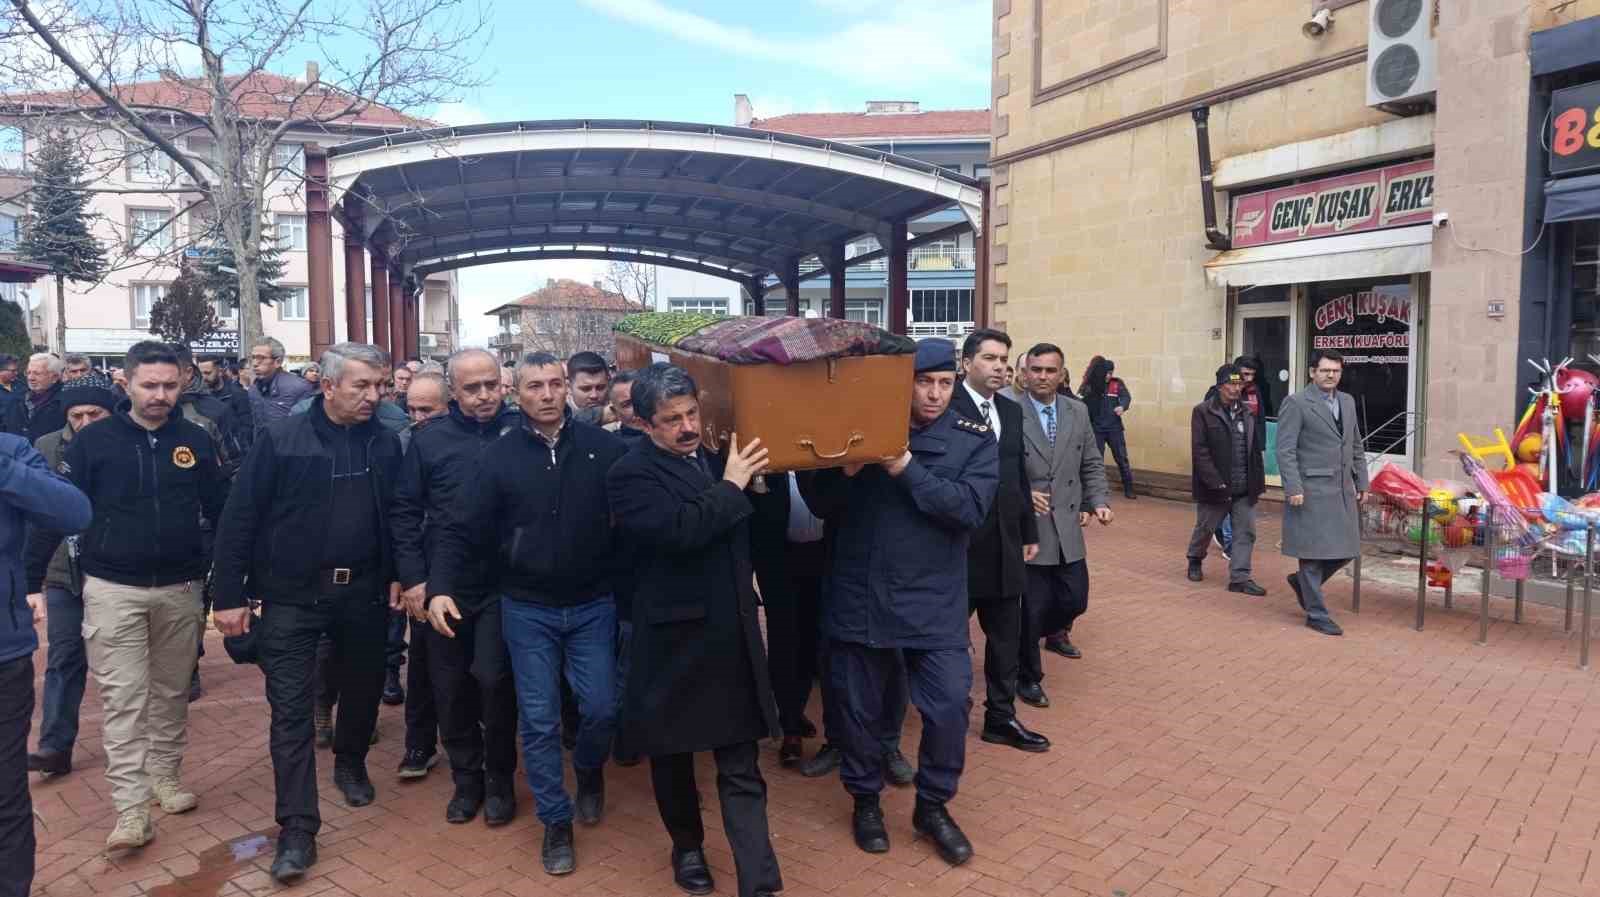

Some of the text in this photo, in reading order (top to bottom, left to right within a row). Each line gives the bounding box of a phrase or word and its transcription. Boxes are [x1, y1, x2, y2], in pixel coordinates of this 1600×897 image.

[1272, 185, 1376, 233] GENÇ KUŞAK
[1315, 291, 1410, 330] GENÇ KUŞAK
[1314, 335, 1353, 349] ERKEK
